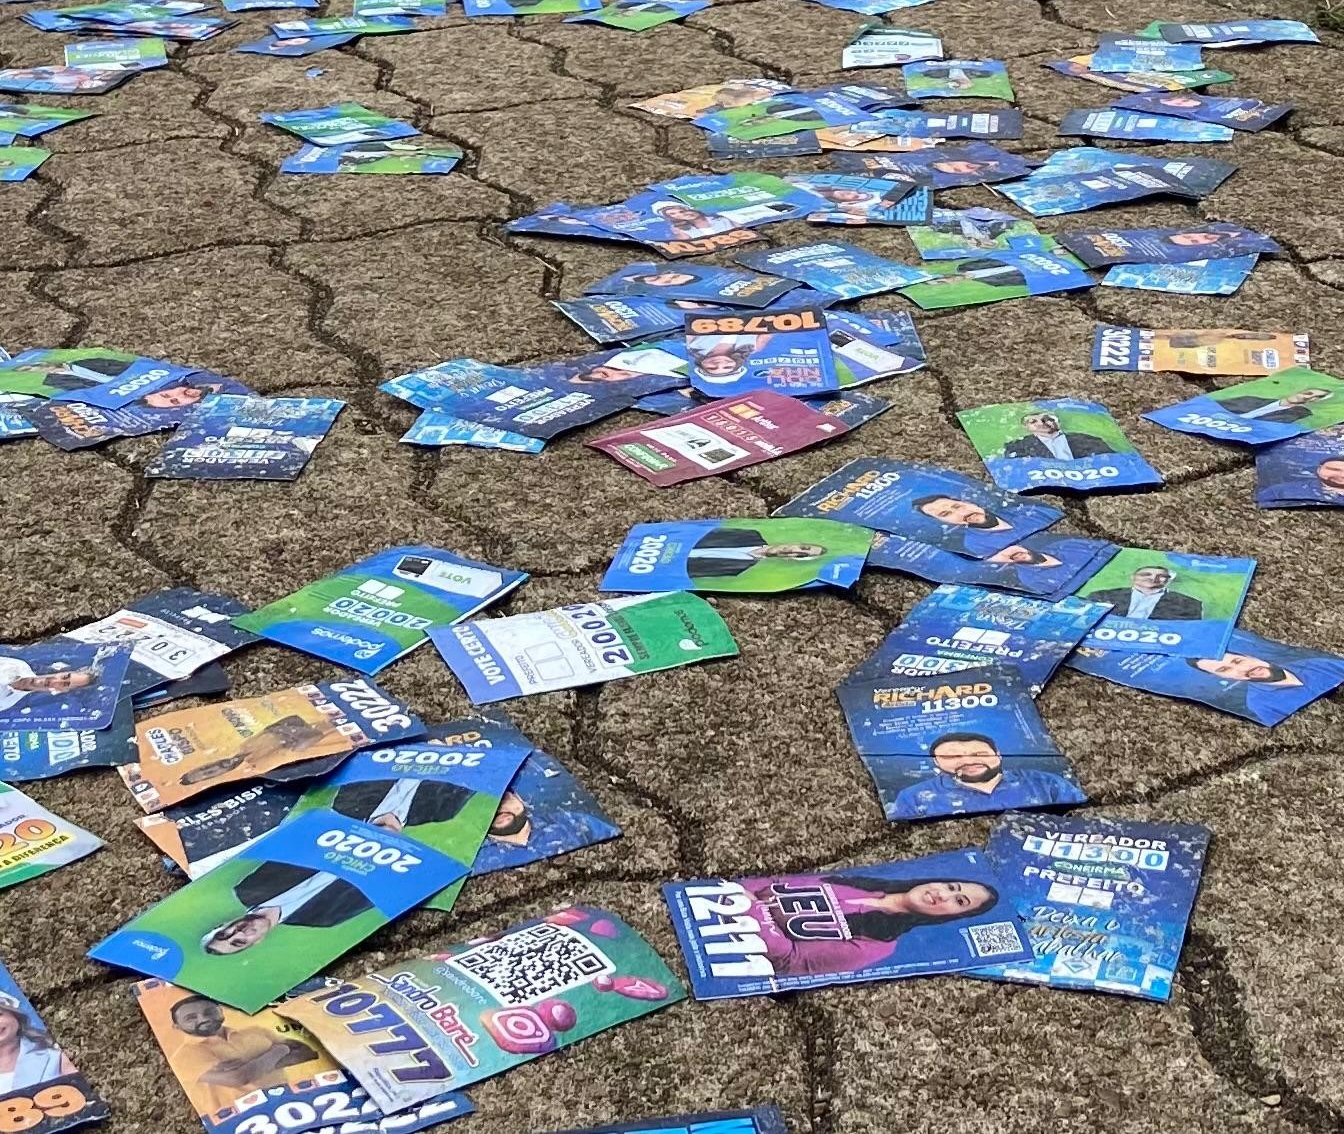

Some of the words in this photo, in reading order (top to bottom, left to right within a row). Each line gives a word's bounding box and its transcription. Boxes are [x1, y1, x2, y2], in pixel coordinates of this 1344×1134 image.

[691, 311, 820, 334] 10.789
[1177, 412, 1253, 434] 20020
[1026, 466, 1120, 483] 20020
[629, 534, 668, 575] 20020
[328, 597, 433, 629] 20020
[311, 627, 386, 660] podemos
[673, 609, 710, 648] podemos
[925, 636, 1023, 658] PREFEITO
[478, 651, 506, 687] VOTE
[329, 679, 413, 734] 30222
[873, 682, 992, 706] RICHARD
[920, 694, 999, 715] 11300
[146, 729, 183, 765] CHARLES
[372, 747, 486, 768] 20020
[226, 785, 265, 810] BISP
[317, 829, 422, 874] 20020
[1029, 840, 1166, 867] 11300
[1045, 830, 1168, 851] VEREADOR
[1022, 866, 1145, 896] PREFEITO
[1054, 861, 1127, 876] CONFIRMA
[771, 881, 844, 941] JEU
[1032, 905, 1096, 929] Deixa
[1104, 920, 1122, 932] o
[685, 879, 776, 978] 12111
[309, 982, 457, 1084] 10777
[369, 971, 441, 1014] Sandro
[430, 1003, 481, 1068] Baré
